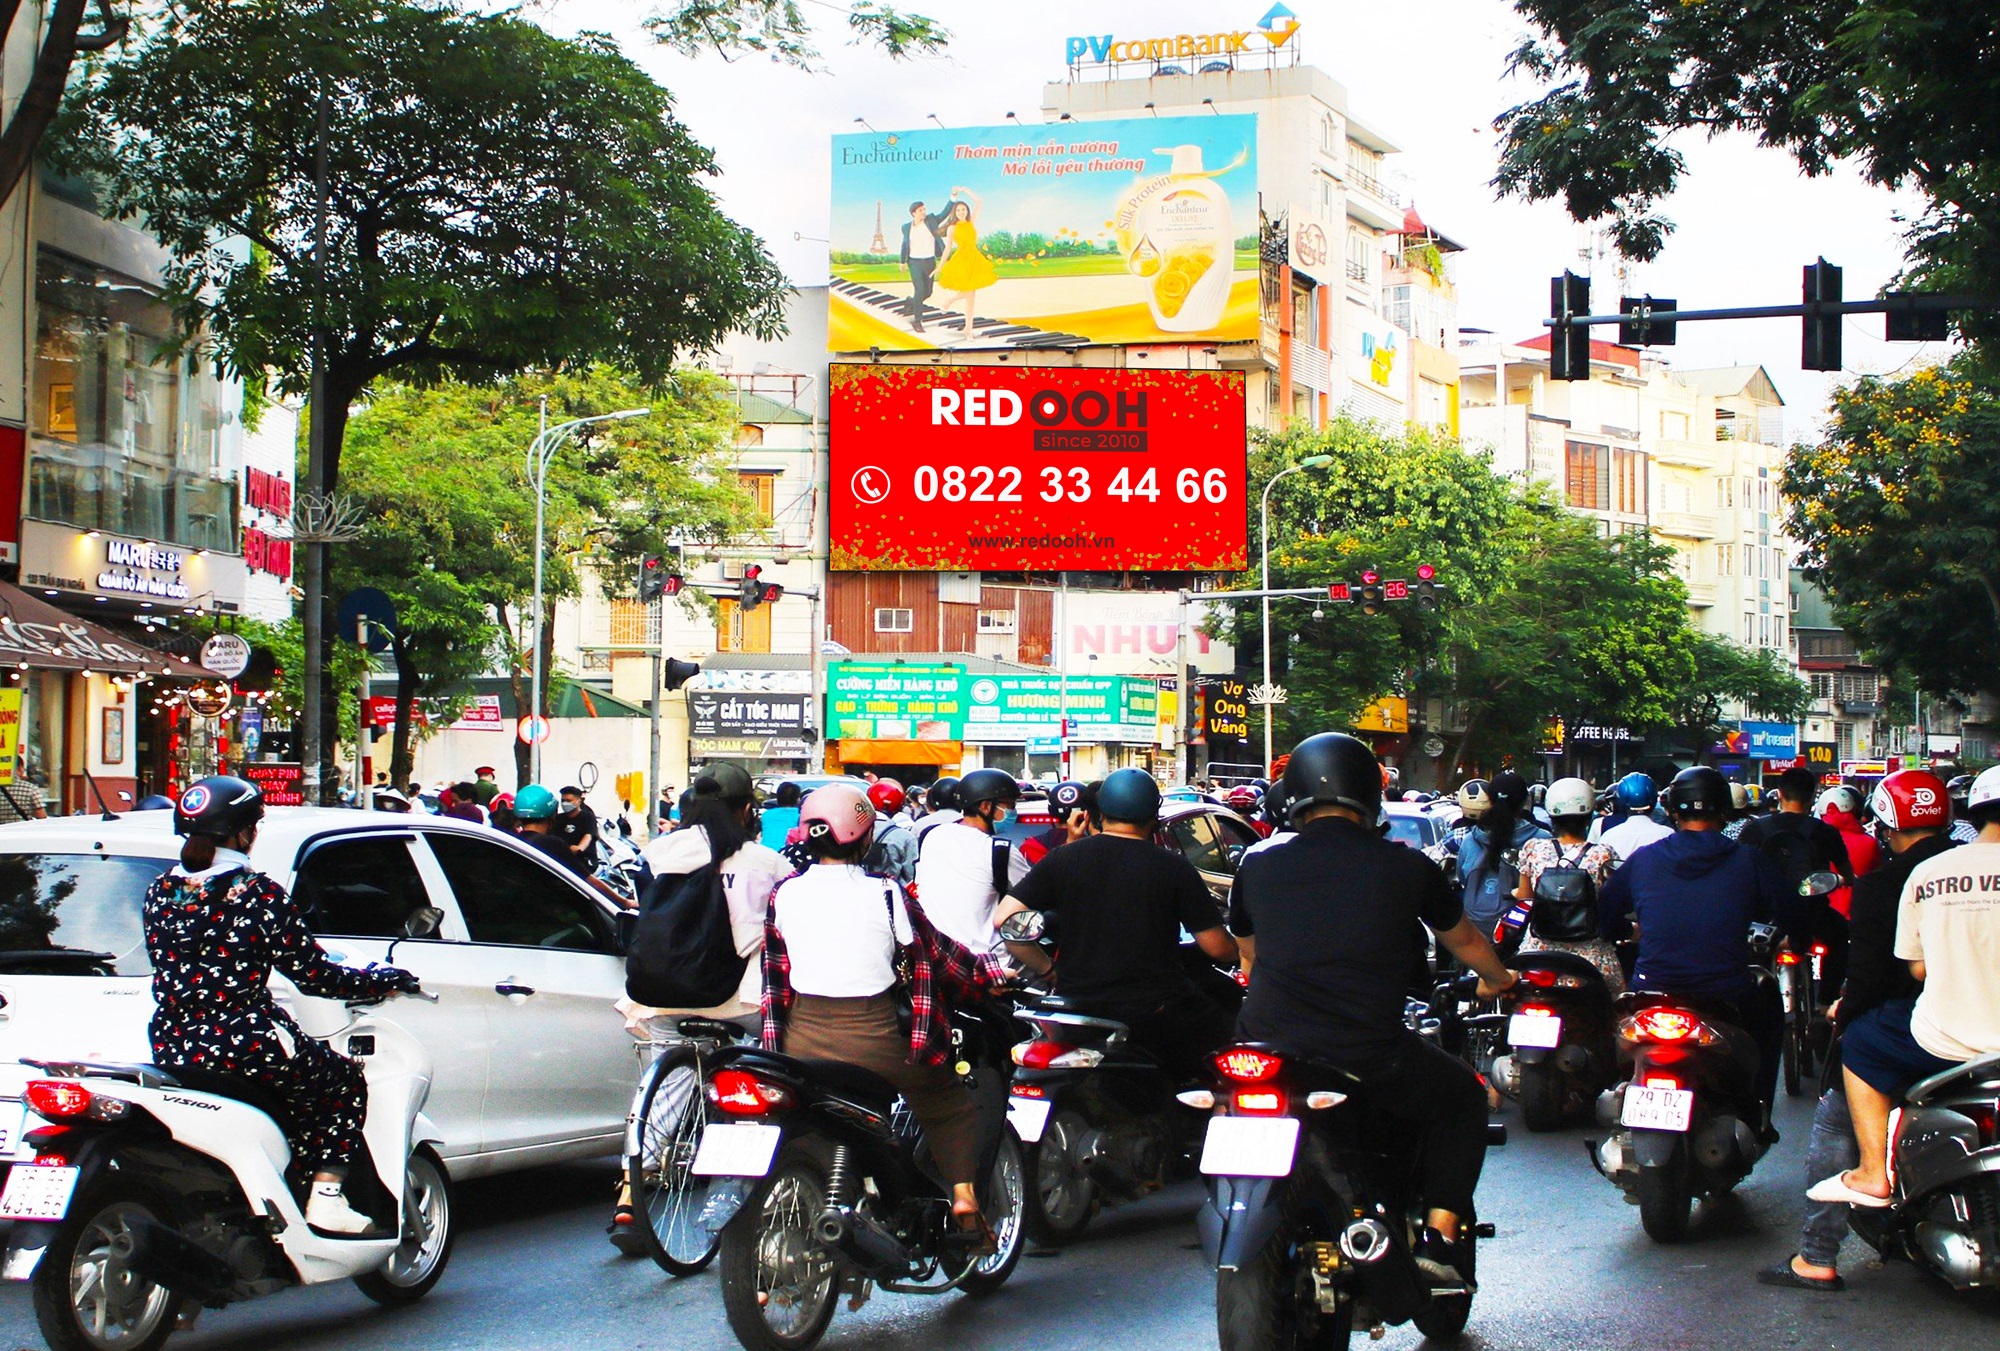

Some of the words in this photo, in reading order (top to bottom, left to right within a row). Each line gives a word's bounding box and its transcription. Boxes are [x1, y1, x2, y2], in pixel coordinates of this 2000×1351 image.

[842, 141, 943, 165] Enchanteur
[955, 146, 998, 159] Thơm
[1002, 144, 1032, 160] mịn
[1070, 141, 1119, 156] vương
[1055, 160, 1084, 176] yêu
[1088, 158, 1146, 173] thương
[1118, 207, 1136, 230] Silk
[1128, 175, 1171, 209] Protein
[1160, 203, 1210, 215] Enchanteur
[931, 388, 1023, 426] RED
[1030, 390, 1148, 428] OOH
[1041, 433, 1092, 449] since
[1097, 434, 1140, 449] 2010
[913, 466, 1022, 502] 0822
[1040, 467, 1092, 502] 33
[1107, 467, 1161, 502] 44
[1175, 468, 1228, 503] 66
[967, 533, 1115, 548] www.redooh.vn
[107, 541, 150, 568] MARU
[1387, 582, 1406, 597] 26
[1222, 681, 1244, 698] Vợ
[720, 697, 745, 719] CẮT
[746, 700, 770, 720] TÓC
[771, 703, 800, 720] NAM
[1066, 695, 1106, 708] MINH
[1214, 700, 1246, 718] Ong
[1210, 716, 1248, 737] Vàng
[717, 740, 741, 752] NAM
[742, 740, 762, 752] 40K
[278, 769, 298, 778] PIN
[1910, 805, 1942, 817] goviet
[1914, 875, 1973, 903] ASTRO
[163, 1094, 222, 1111] VISION
[1635, 1090, 1654, 1106] 29
